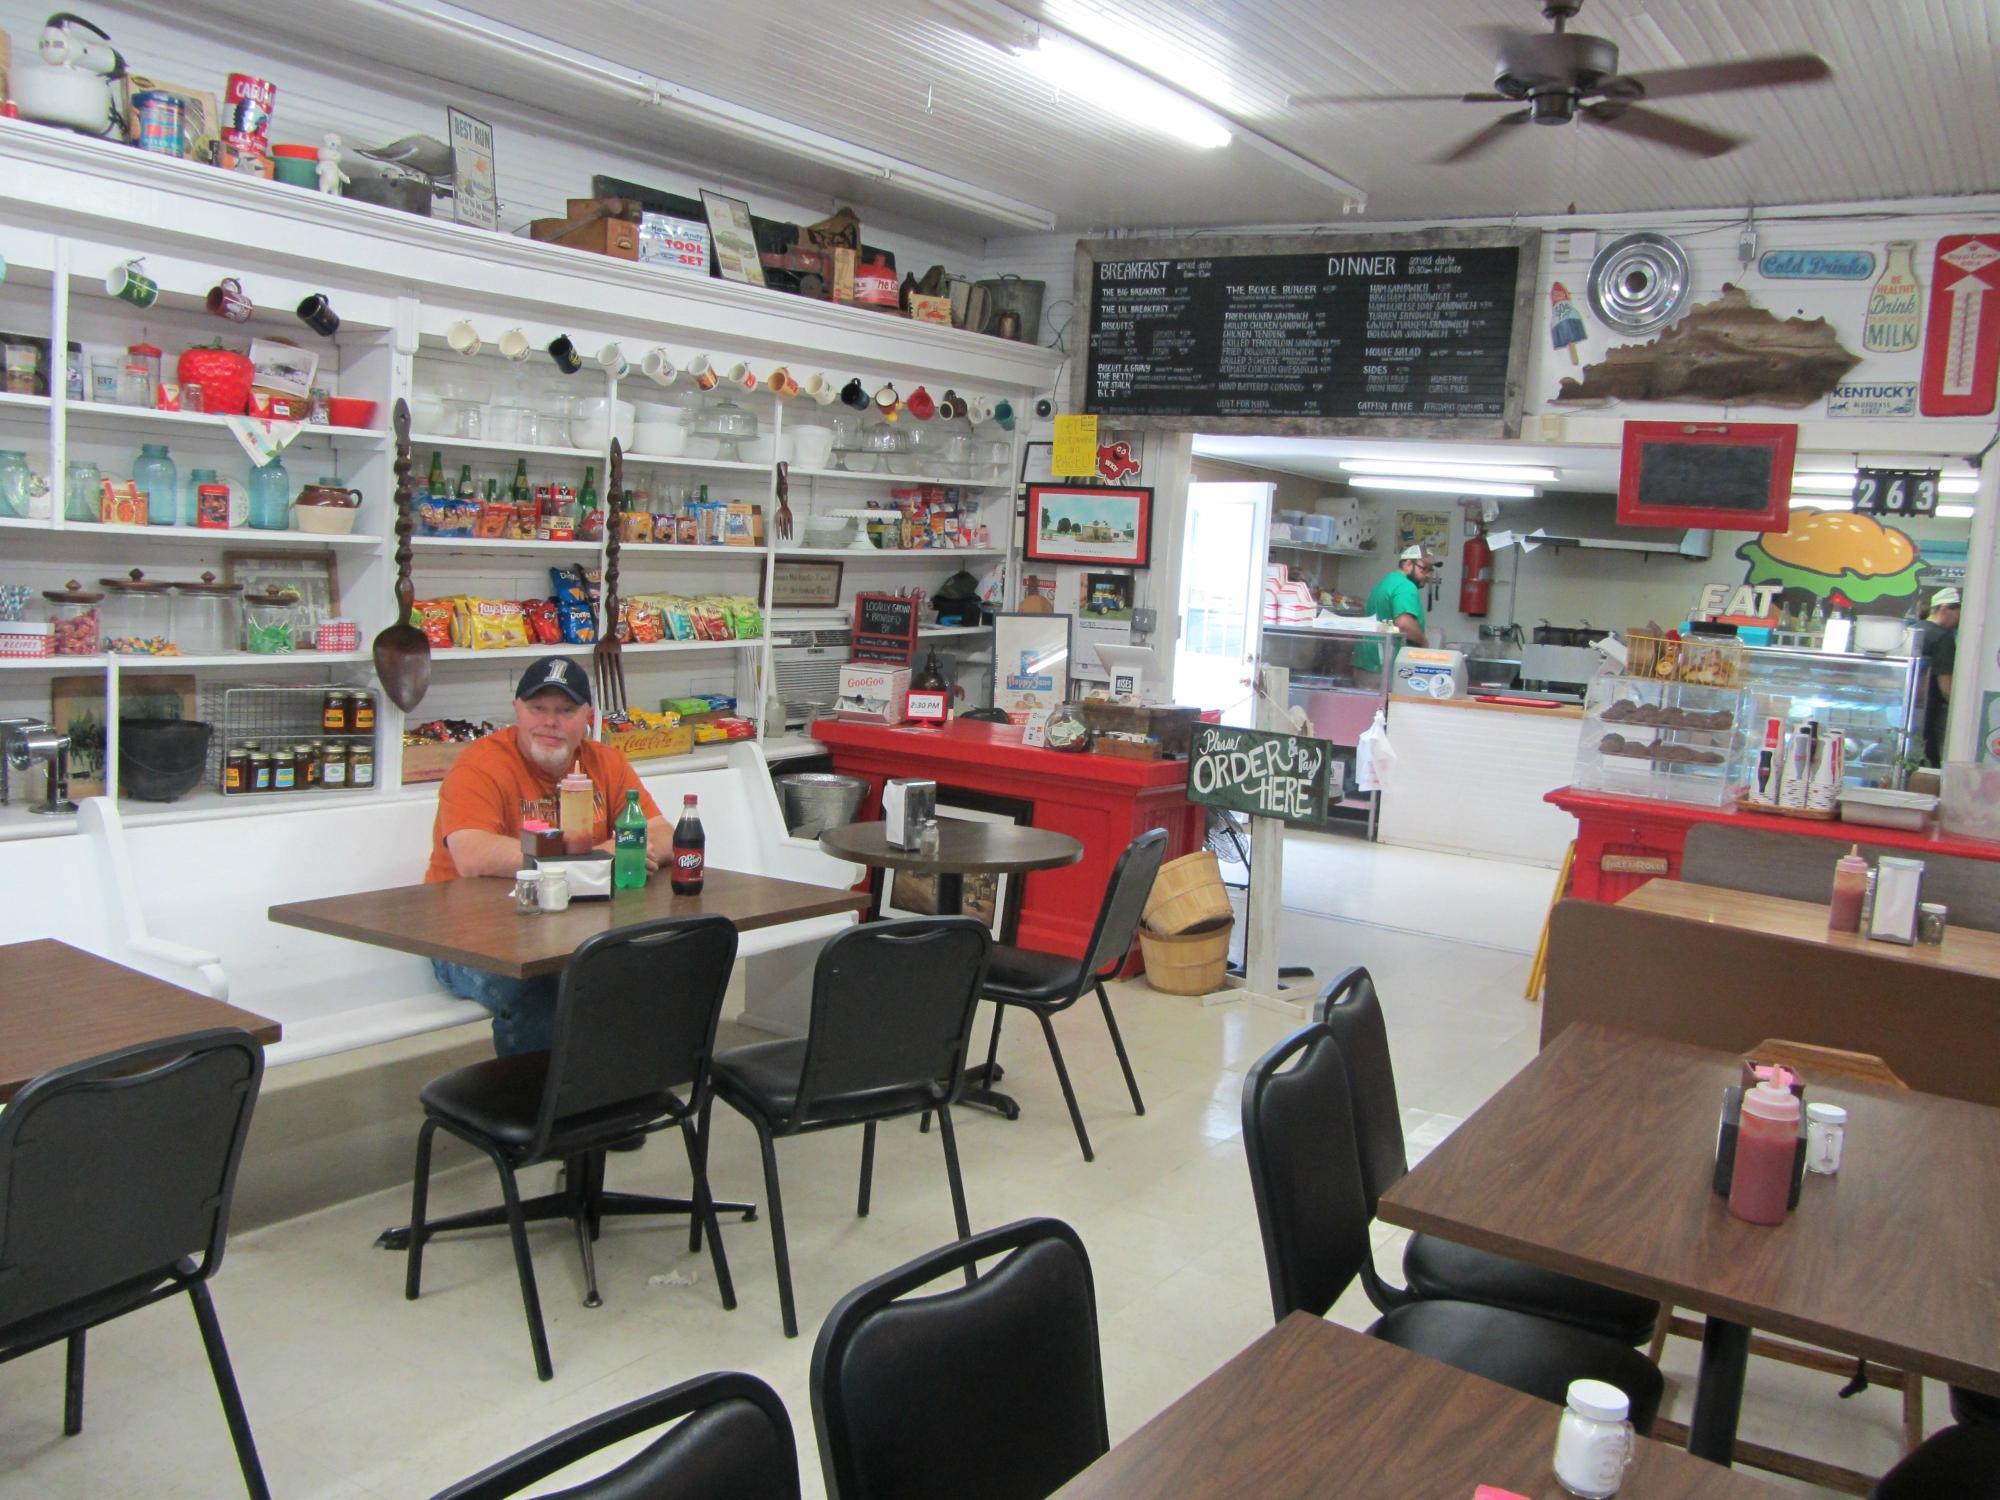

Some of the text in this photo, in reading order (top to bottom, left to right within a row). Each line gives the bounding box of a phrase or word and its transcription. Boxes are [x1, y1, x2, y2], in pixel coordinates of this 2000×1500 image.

[454, 117, 491, 150] BEST RUN
[665, 239, 704, 254] TOOL
[678, 255, 704, 266] SET
[1328, 257, 1396, 276] DINNER
[1435, 255, 1456, 265] daily
[1763, 256, 1869, 276] Cold Drinks
[1100, 261, 1170, 280] BREAKFAST
[1102, 287, 1167, 297] THE BIG BREAKFAST
[1226, 286, 1246, 295] THE
[1282, 285, 1318, 295] BURGER
[1101, 305, 1115, 313] THE
[1130, 304, 1169, 313] BREAKFAST
[1871, 294, 1916, 315] Drink
[1274, 312, 1309, 320] SANDWICH
[1101, 321, 1134, 330] BISCUITS
[1279, 321, 1314, 330] SANDWICH
[1869, 324, 1915, 347] MILK
[1394, 347, 1421, 357] SALAD
[1362, 365, 1387, 375] SIDES
[1097, 373, 1110, 381] THE
[1097, 381, 1109, 389] THE
[1833, 386, 1915, 398] KENTUCKY
[866, 600, 890, 612] LOCALLY
[1698, 583, 1780, 619] EAT
[847, 676, 884, 688] GooGoo
[1200, 729, 1241, 755] Please
[1193, 739, 1294, 794] ORDER
[1298, 747, 1322, 781] Pay
[1241, 776, 1313, 818] HERE
